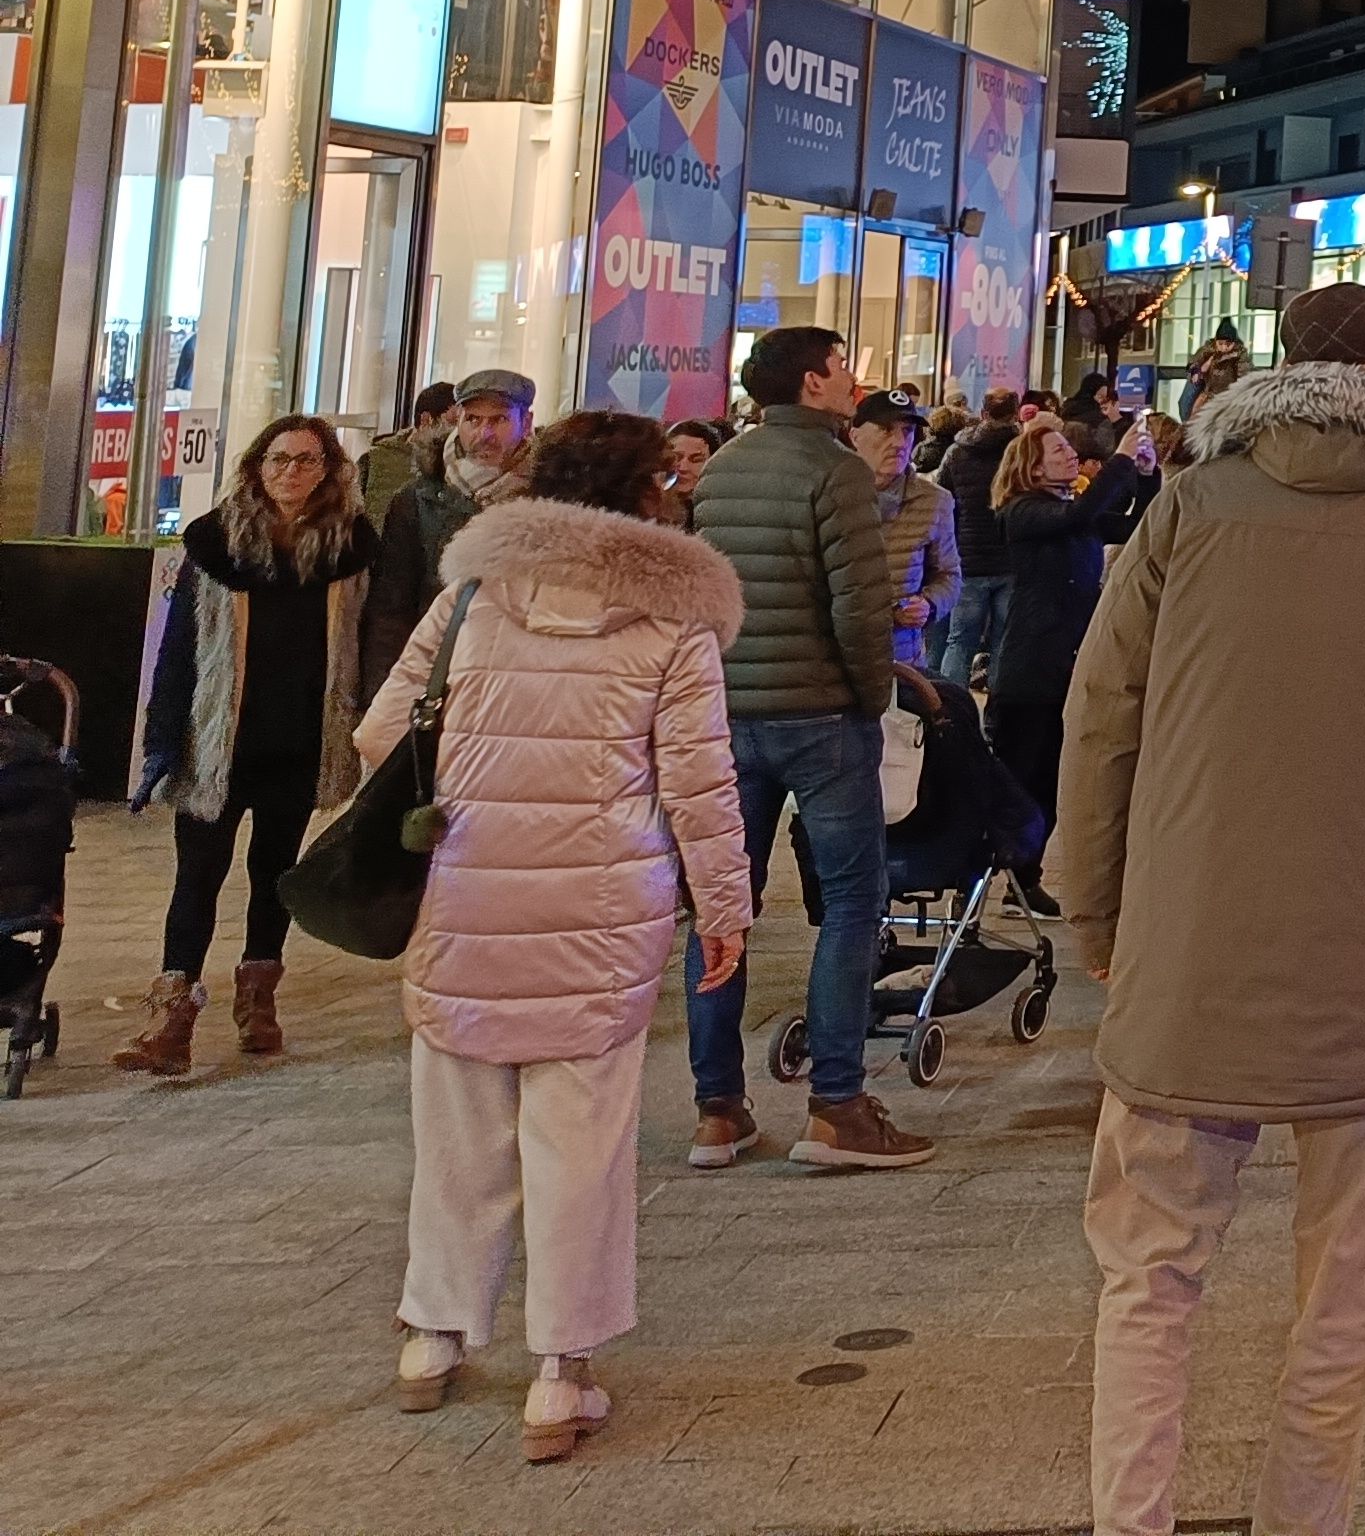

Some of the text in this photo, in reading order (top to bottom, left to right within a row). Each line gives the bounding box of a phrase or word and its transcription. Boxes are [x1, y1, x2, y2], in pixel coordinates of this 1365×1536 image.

[644, 37, 721, 77] DOCKERS
[765, 39, 860, 107] OUTLET
[774, 103, 844, 140] VIA MODA
[885, 77, 947, 129] JEANS
[625, 146, 722, 191] HUGO BOSS
[604, 234, 727, 296] OUTLET
[960, 263, 1023, 329] -80%
[607, 342, 712, 373] JACK&JONES
